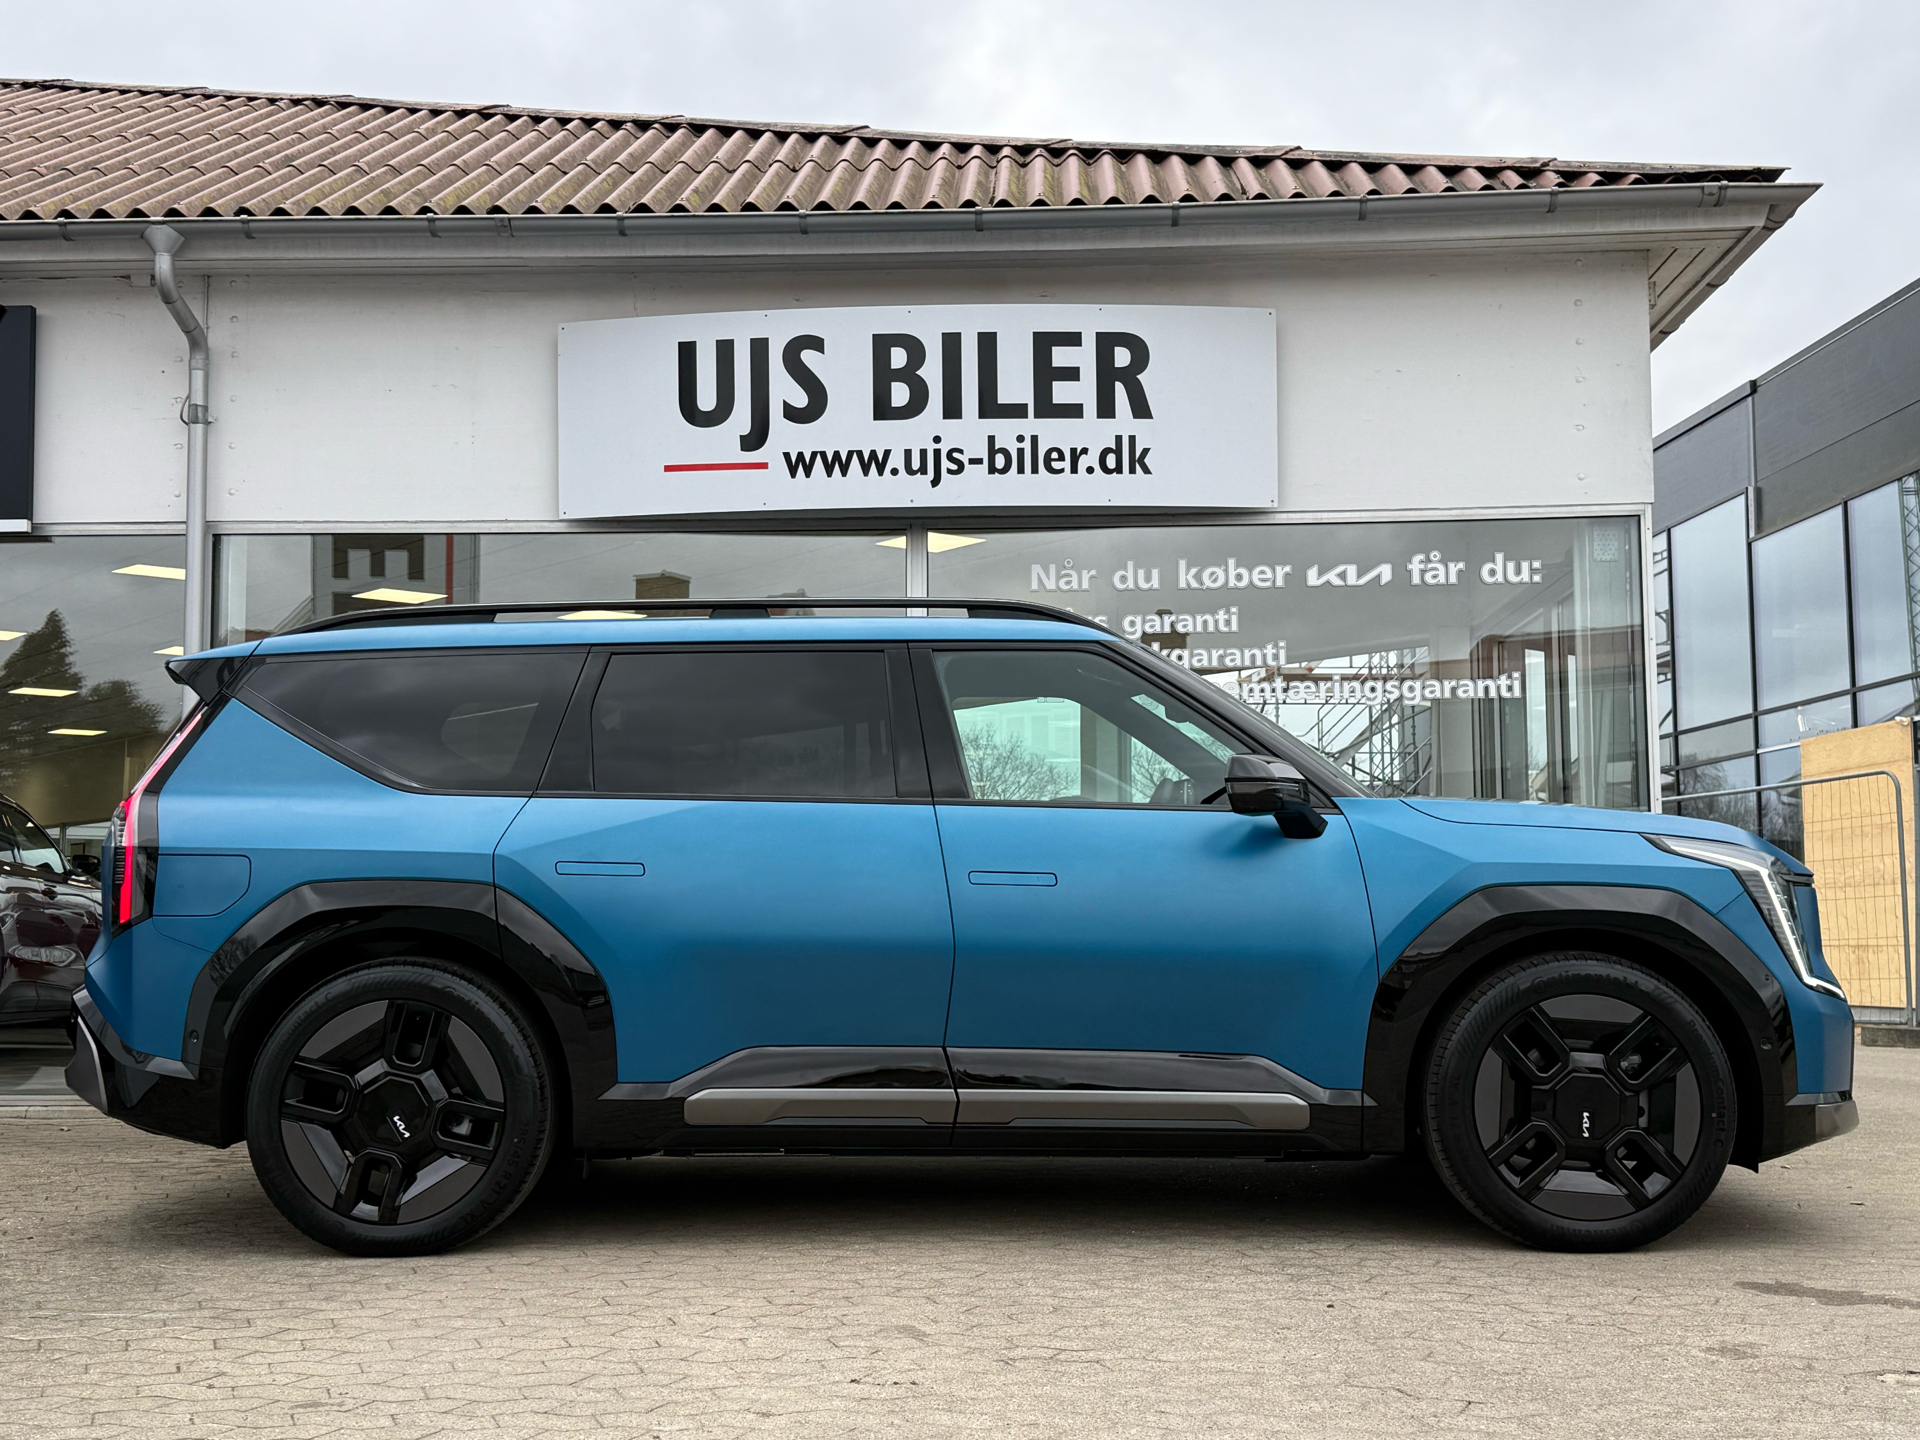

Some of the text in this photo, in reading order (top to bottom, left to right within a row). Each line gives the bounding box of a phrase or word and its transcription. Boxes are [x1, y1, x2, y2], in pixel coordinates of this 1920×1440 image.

[677, 330, 1154, 453] UJS BILER
[783, 434, 1154, 488] www.ujs-biler.dk
[1030, 558, 1098, 591] Når
[1112, 560, 1160, 590] du
[1177, 557, 1292, 590] køber
[1407, 550, 1465, 586] får
[1480, 551, 1542, 585] du:
[1121, 606, 1239, 639] garanti
